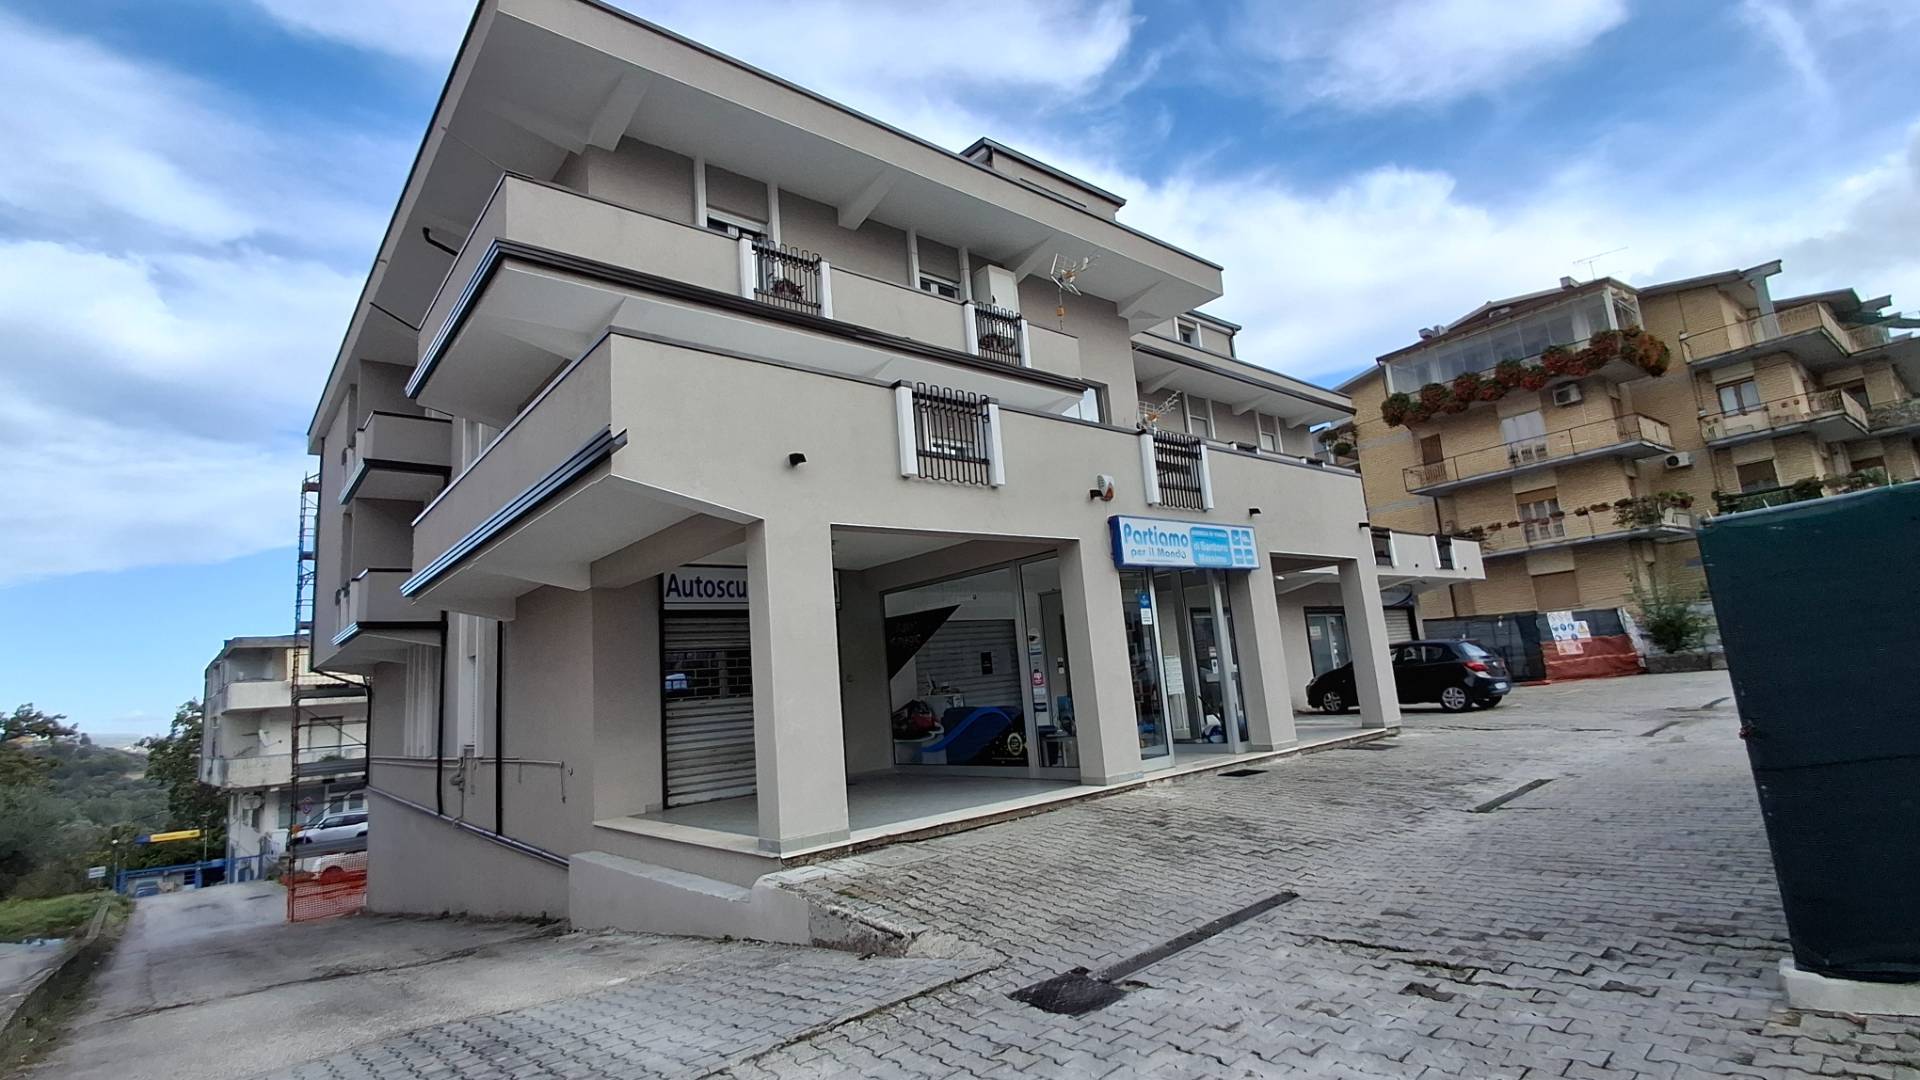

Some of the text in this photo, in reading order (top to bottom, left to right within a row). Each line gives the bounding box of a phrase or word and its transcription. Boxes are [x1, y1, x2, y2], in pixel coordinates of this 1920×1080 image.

[1123, 523, 1189, 547] Partiamo
[1131, 548, 1146, 559] per
[666, 573, 747, 598] Autoscu
